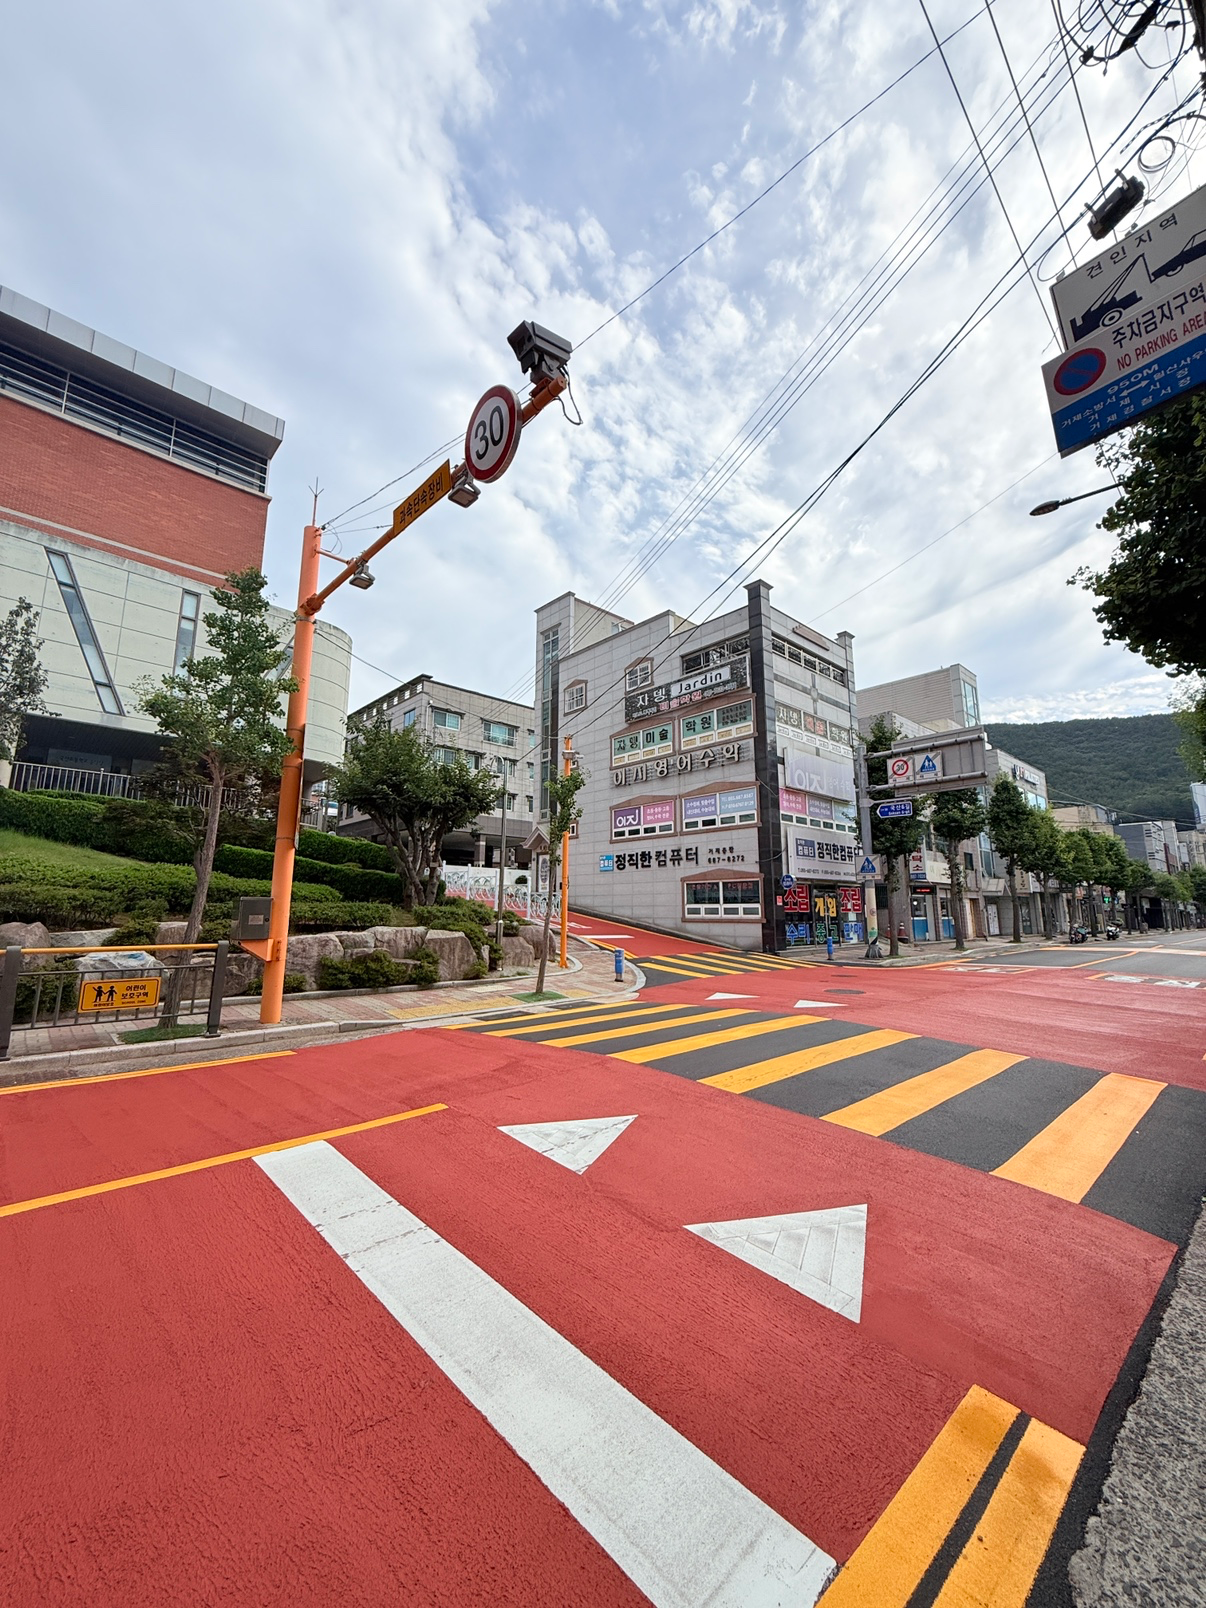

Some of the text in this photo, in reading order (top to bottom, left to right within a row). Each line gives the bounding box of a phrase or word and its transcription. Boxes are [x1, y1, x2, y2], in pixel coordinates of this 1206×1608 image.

[1086, 212, 1178, 279] 견인지역
[1112, 282, 1206, 349] 주차금지구역
[1117, 353, 1132, 371] NO
[1135, 328, 1178, 362] PARKING
[1107, 363, 1159, 395] 950M
[1061, 395, 1117, 429] 거제소방서
[474, 405, 504, 461] 30
[399, 472, 444, 525] 과속단속장비
[678, 671, 722, 694] Jardin
[645, 728, 668, 744] 미술
[685, 715, 711, 733] 학원
[616, 809, 639, 828] 이지
[840, 887, 862, 913] 조립
[786, 923, 811, 944] 수리
[816, 923, 839, 943] 중고
[121, 991, 149, 1000] 보호구역
[125, 984, 147, 992] 어린이
